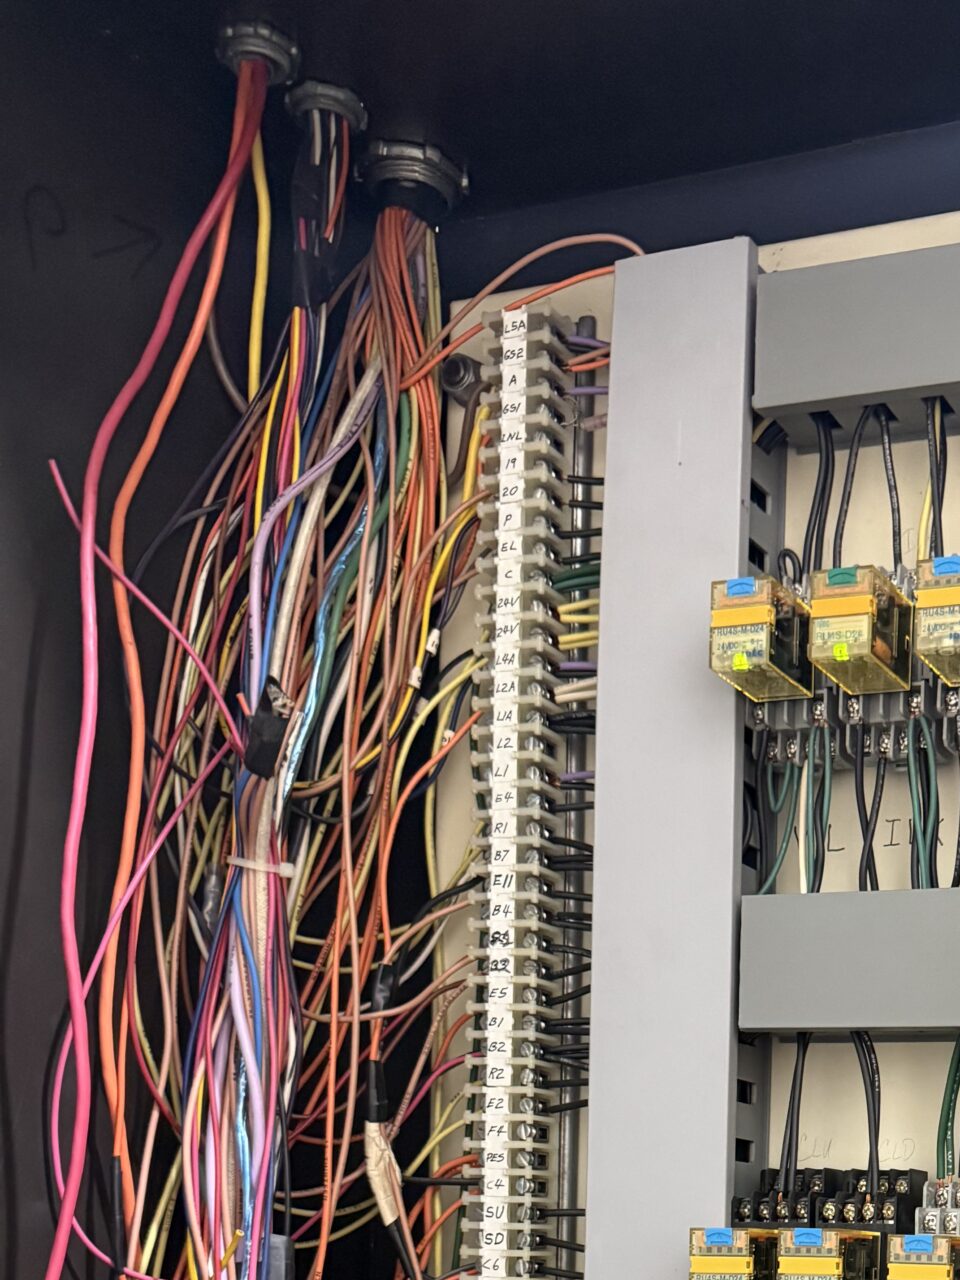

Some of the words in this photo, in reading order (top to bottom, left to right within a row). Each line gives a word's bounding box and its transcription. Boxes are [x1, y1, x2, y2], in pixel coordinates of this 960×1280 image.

[509, 374, 518, 385] A
[506, 457, 517, 469] 19
[502, 486, 519, 497] 20
[503, 514, 513, 527] P
[501, 541, 518, 552] EL
[505, 570, 513, 579] C
[497, 596, 520, 609] 24V
[496, 622, 520, 638] 24V
[496, 653, 516, 665] L4A
[743, 650, 763, 658] DEC
[496, 682, 516, 694] L2A
[496, 737, 514, 749] L2
[495, 765, 509, 777] L1
[494, 822, 508, 834] R1
[494, 850, 509, 862] B7
[492, 874, 514, 889] E11
[491, 904, 512, 918] B4
[489, 987, 509, 999] E5
[488, 1017, 504, 1028] B1
[488, 1041, 507, 1052] B2
[488, 1067, 505, 1080] R2
[486, 1098, 504, 1109] E2
[486, 1179, 505, 1190] C4
[485, 1206, 505, 1219] SU
[484, 1232, 504, 1245] SD
